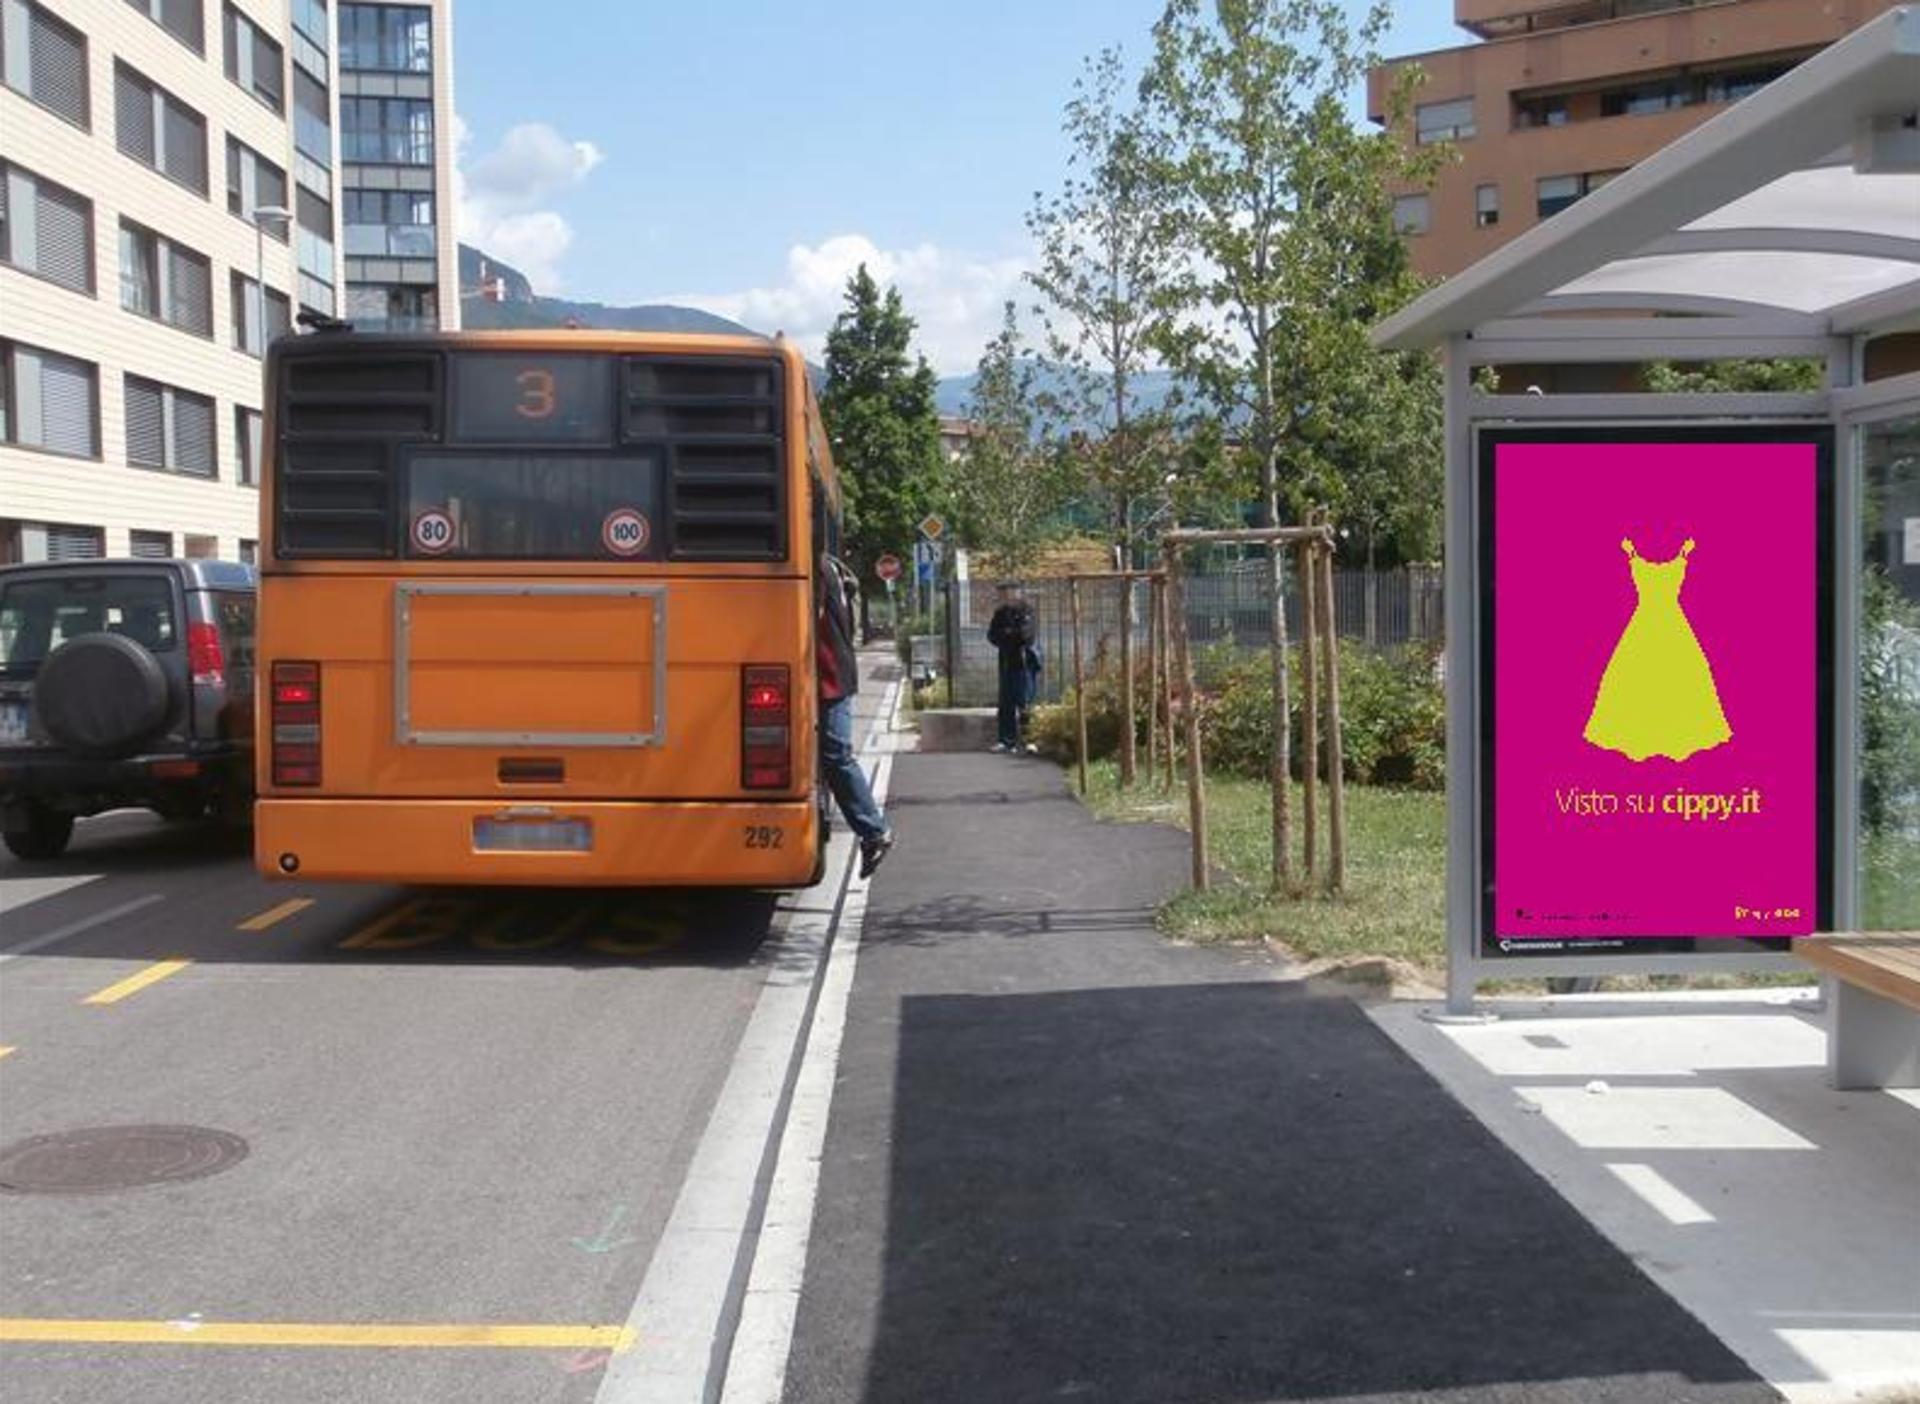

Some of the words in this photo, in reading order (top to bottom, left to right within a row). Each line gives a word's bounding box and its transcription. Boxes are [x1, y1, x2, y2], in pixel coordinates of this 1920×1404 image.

[515, 369, 555, 418] 3
[421, 521, 446, 541] 80
[613, 523, 639, 541] 100
[1556, 787, 1618, 815] Visto
[1626, 794, 1654, 813] su
[1663, 787, 1761, 820] cippy.it
[745, 826, 784, 849] 292
[339, 898, 687, 954] BUS
